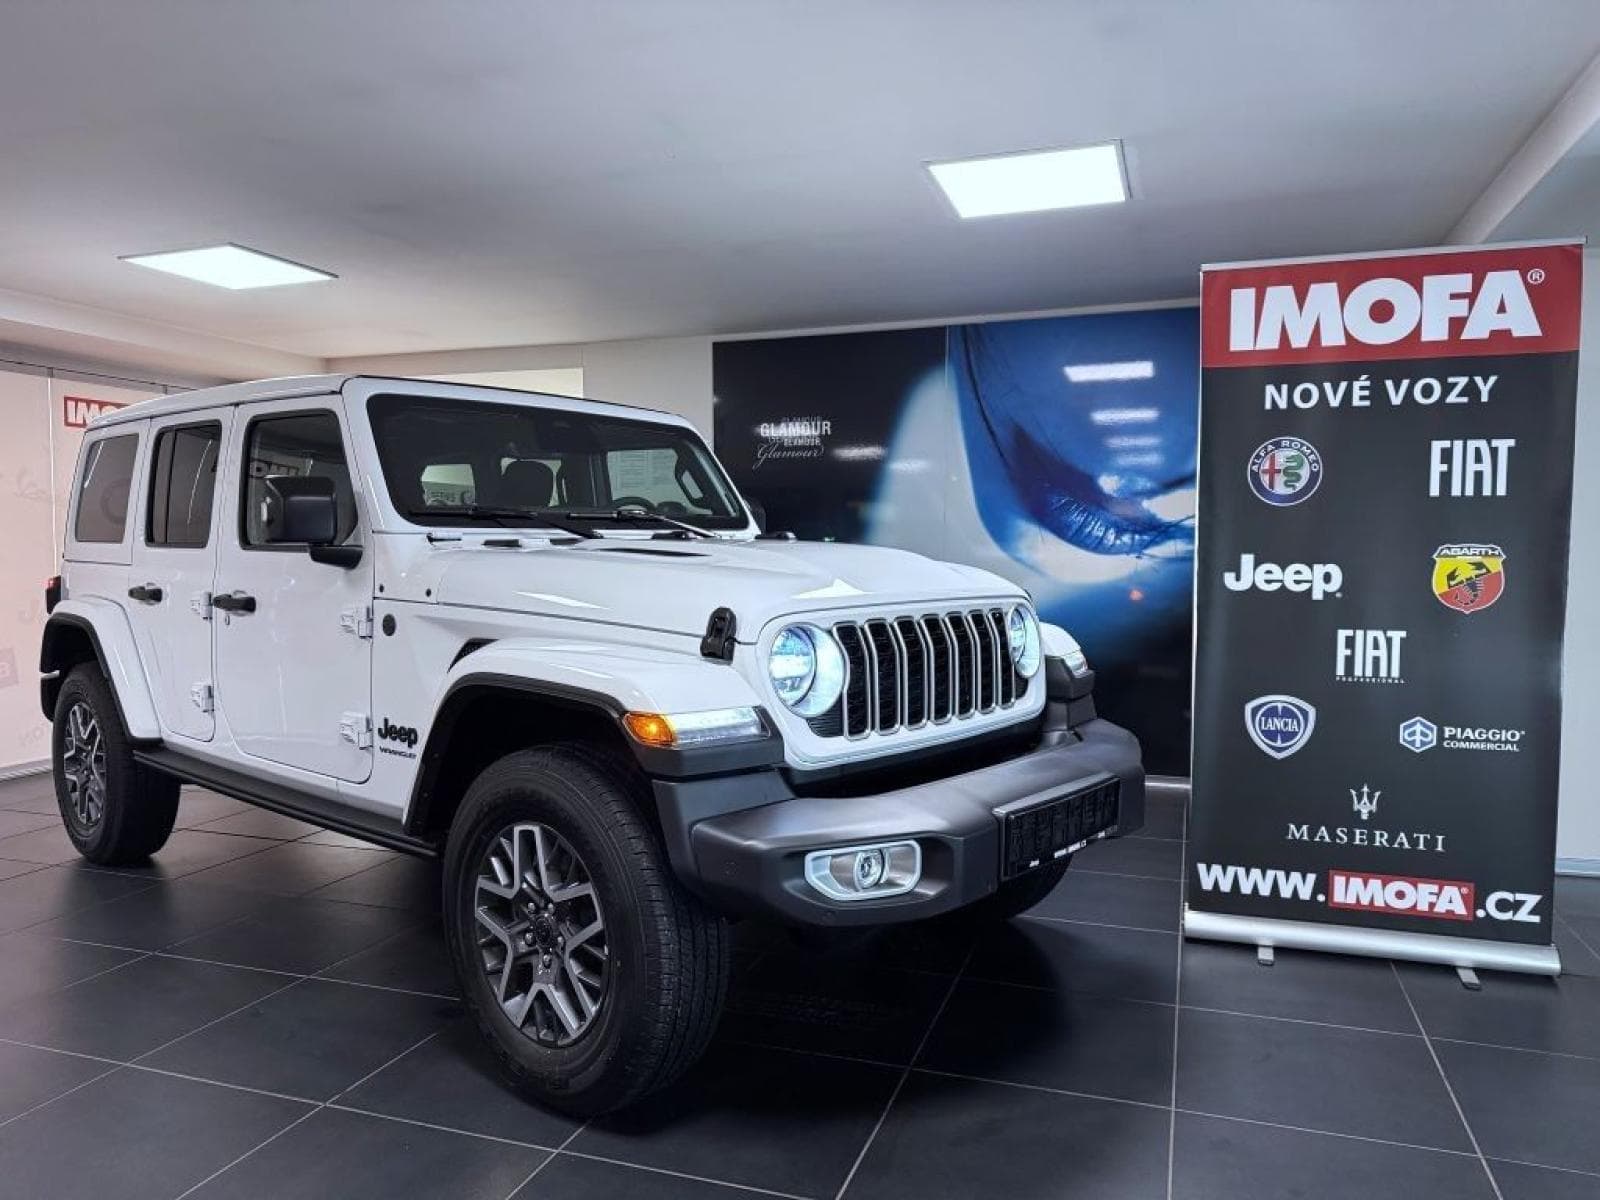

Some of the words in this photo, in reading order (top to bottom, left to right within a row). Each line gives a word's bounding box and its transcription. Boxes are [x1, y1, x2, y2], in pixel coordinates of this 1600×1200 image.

[1264, 374, 1371, 410] NOVÉ
[1384, 375, 1498, 406] VOZY
[760, 421, 831, 437] GLAMOUR
[1251, 445, 1276, 473] ALFA
[1281, 440, 1320, 472] ROMEO
[1428, 438, 1516, 497] FIAT
[1440, 547, 1500, 556] ABARTH
[1223, 553, 1343, 600] Jeep
[1336, 629, 1407, 678] FIAT
[378, 717, 418, 749] Jeep
[1261, 716, 1300, 732] LANCIA
[1443, 740, 1520, 752] COMMERCIAL
[1287, 823, 1446, 852] MASERATI
